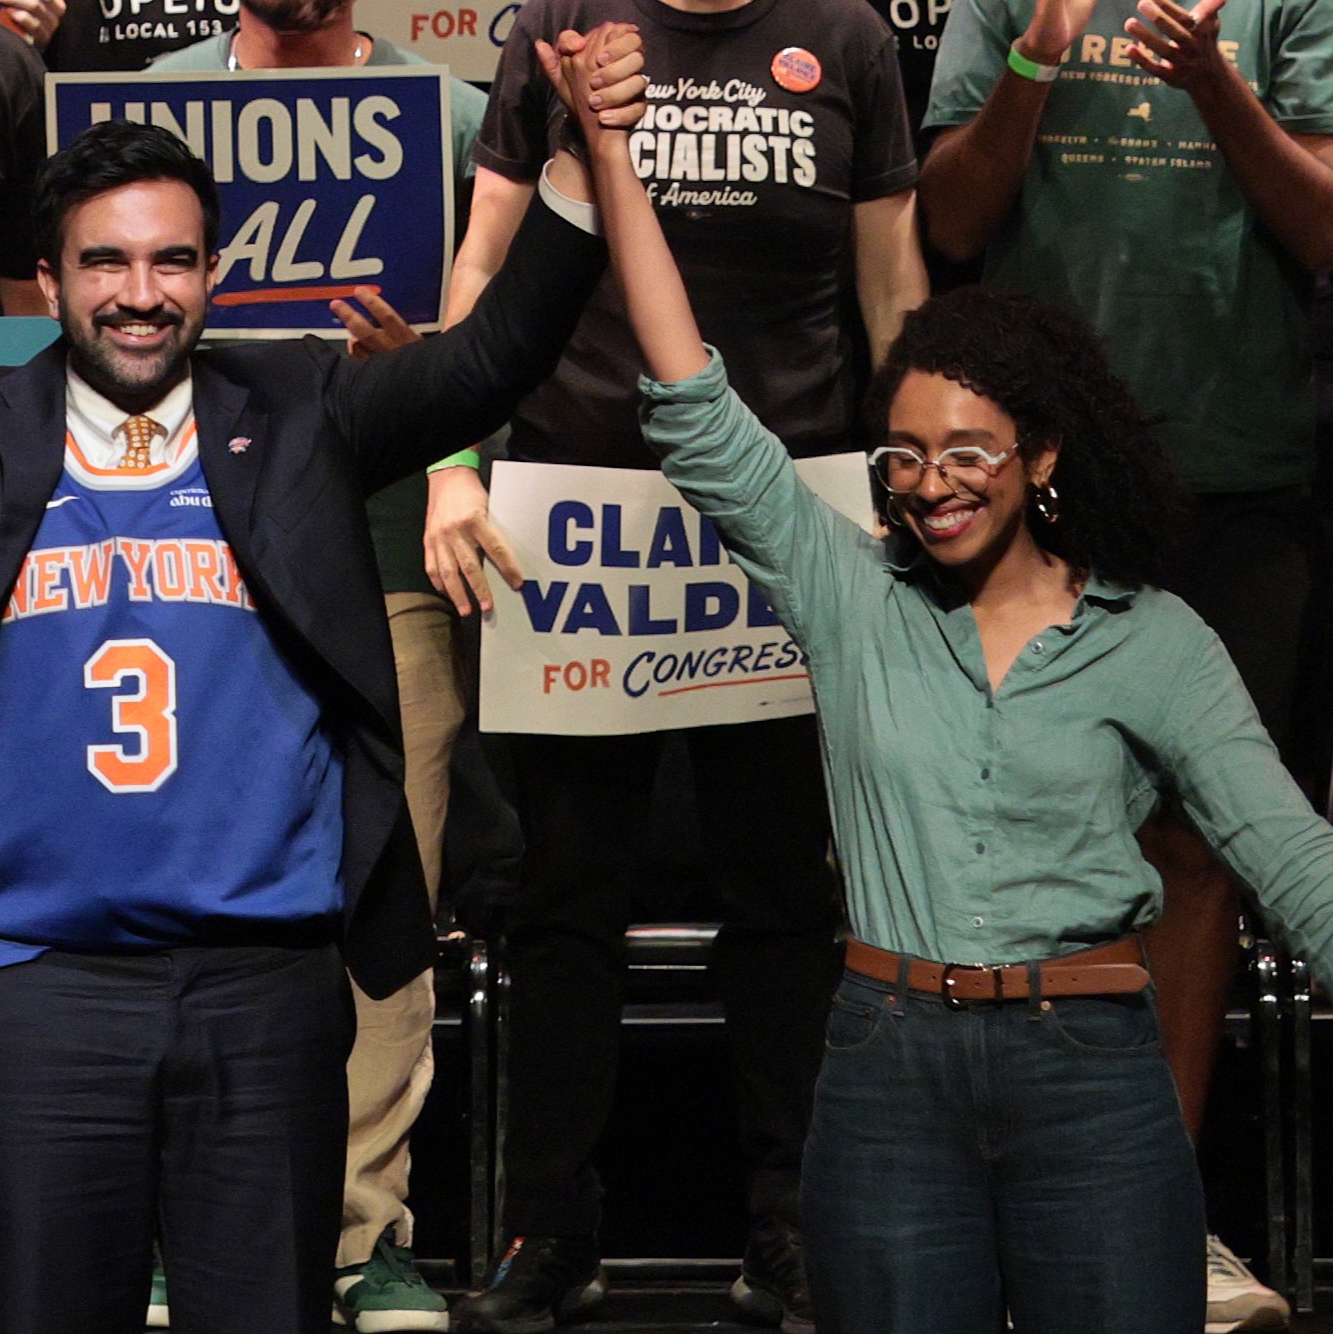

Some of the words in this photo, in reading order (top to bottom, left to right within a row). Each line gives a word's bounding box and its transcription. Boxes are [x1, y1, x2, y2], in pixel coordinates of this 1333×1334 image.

[114, 22, 179, 41] LOCAL
[186, 19, 223, 37] 153
[410, 8, 478, 42] FOR
[675, 77, 724, 101] York
[723, 78, 767, 107] City
[635, 104, 815, 138] MOCRATIC
[628, 130, 817, 188] CIALISTS
[660, 181, 758, 207] America
[215, 193, 385, 284] ALL
[169, 495, 200, 508] abu
[547, 500, 731, 570] CLAI
[1, 538, 115, 624] NEW
[114, 536, 259, 611] YORK
[520, 579, 784, 637] VALDE
[542, 658, 611, 695] FOR
[622, 641, 810, 698] CONGRES
[83, 638, 178, 794] 3
